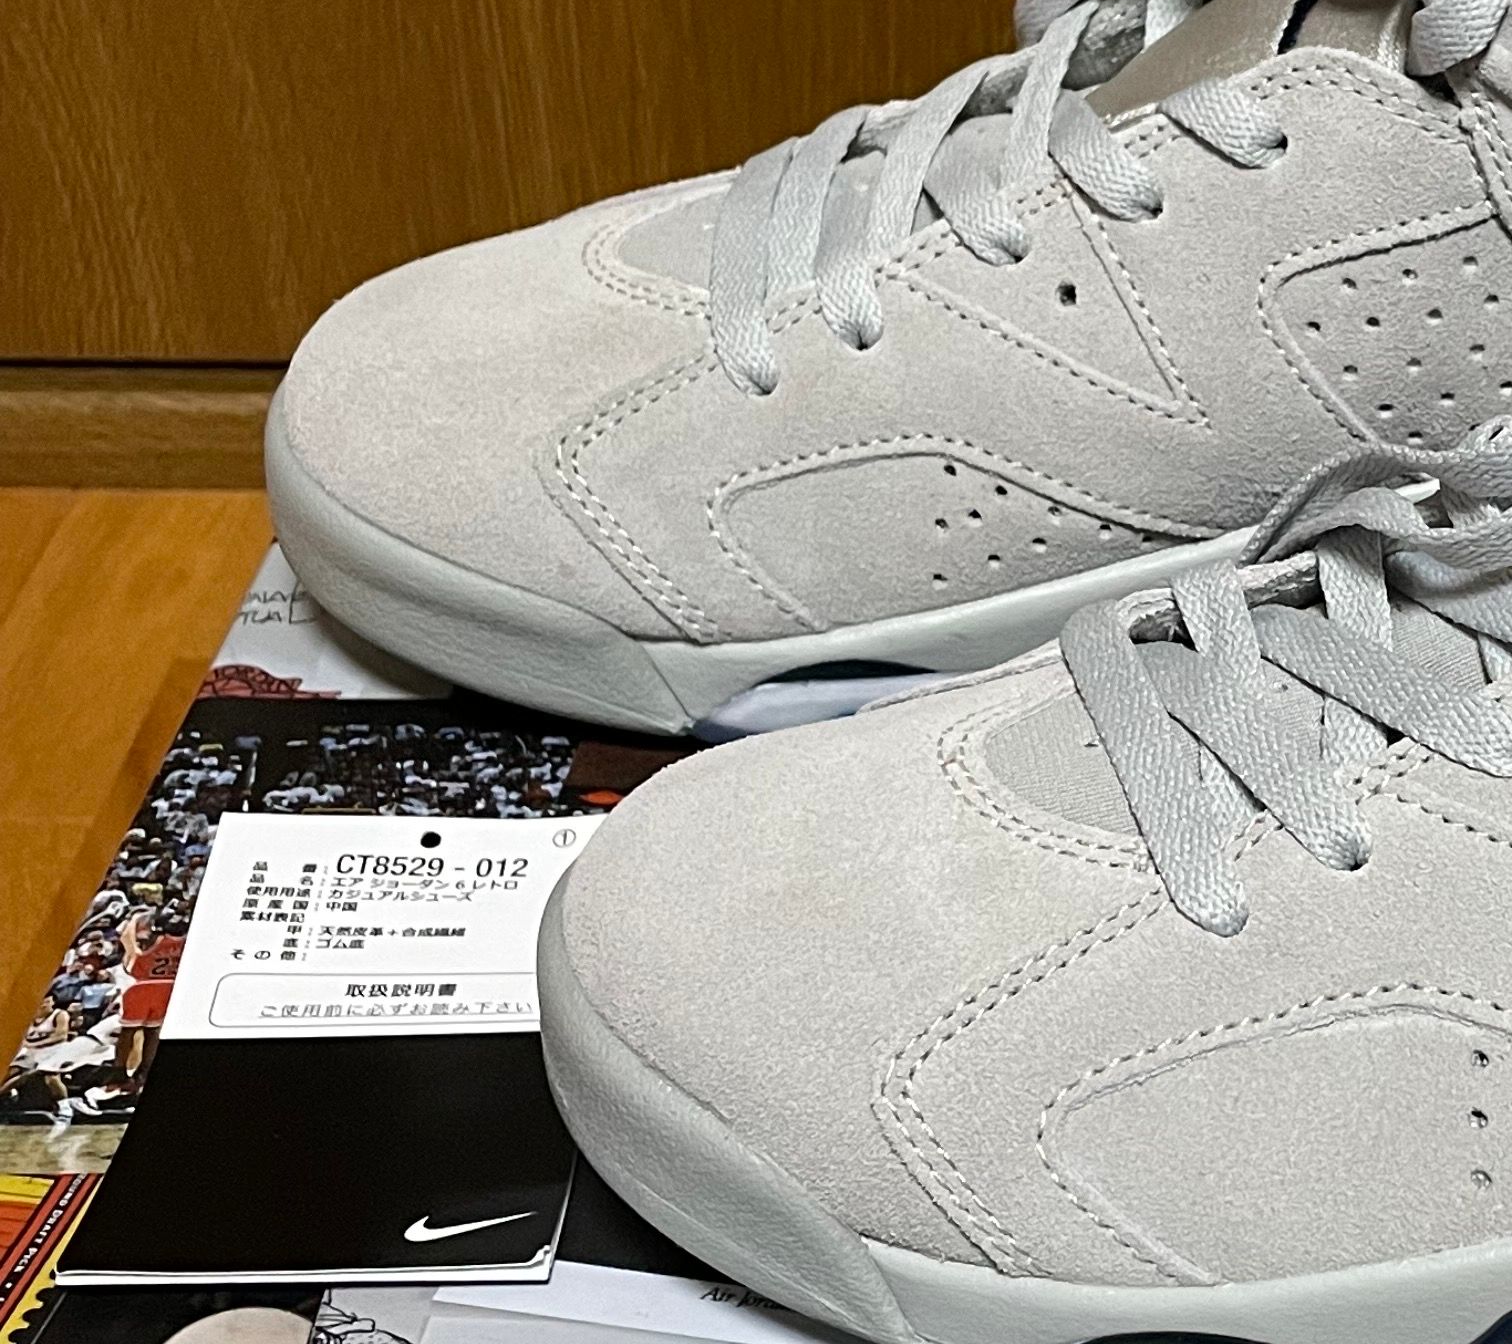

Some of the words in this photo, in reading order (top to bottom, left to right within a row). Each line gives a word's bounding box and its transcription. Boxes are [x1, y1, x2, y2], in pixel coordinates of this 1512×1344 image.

[337, 854, 444, 878] CT8529
[475, 857, 529, 878] 012
[326, 901, 358, 913] 中国
[345, 983, 458, 998] 取扱説明書
[699, 1287, 735, 1302] Air
